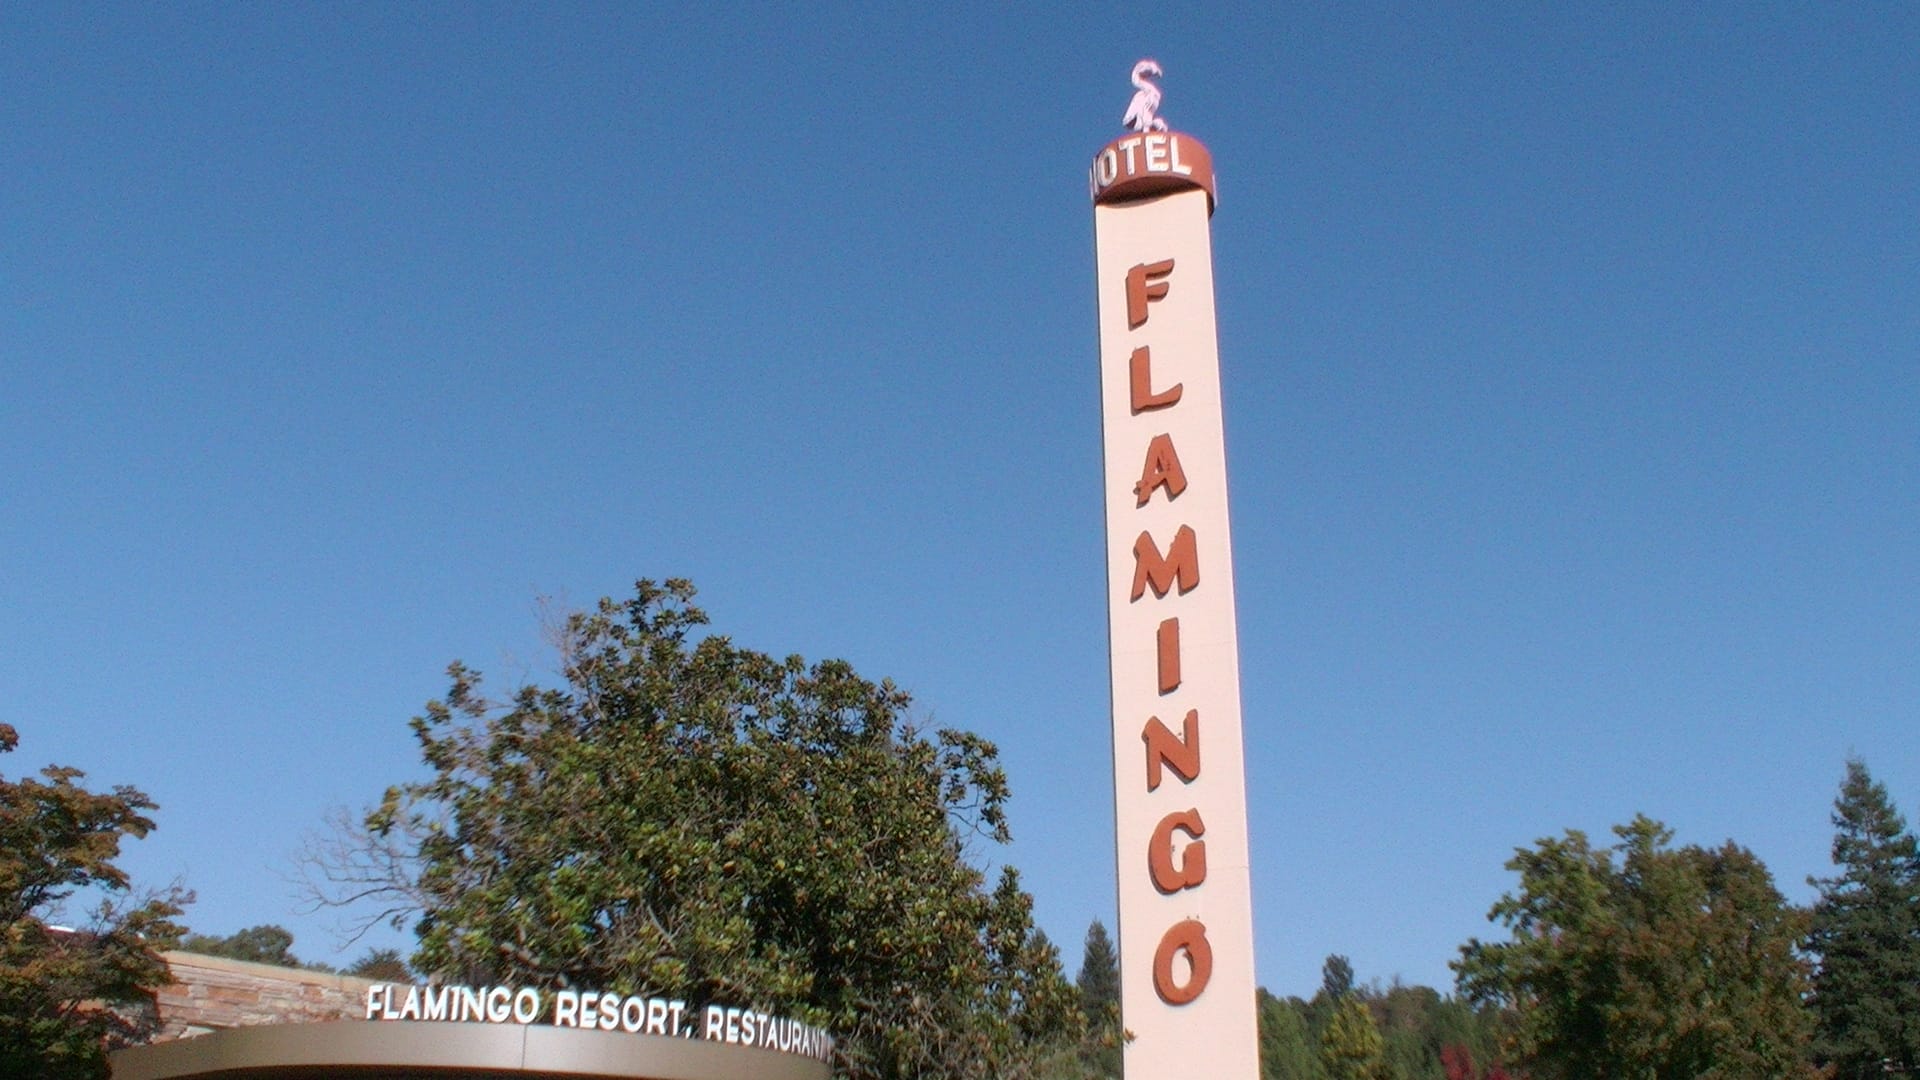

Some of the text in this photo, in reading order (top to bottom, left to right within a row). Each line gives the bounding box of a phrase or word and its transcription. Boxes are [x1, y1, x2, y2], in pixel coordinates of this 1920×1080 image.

[1125, 258, 1213, 1006] FLAMINGO
[366, 984, 539, 1024] FLAMINGO
[554, 990, 692, 1039] RESORT,
